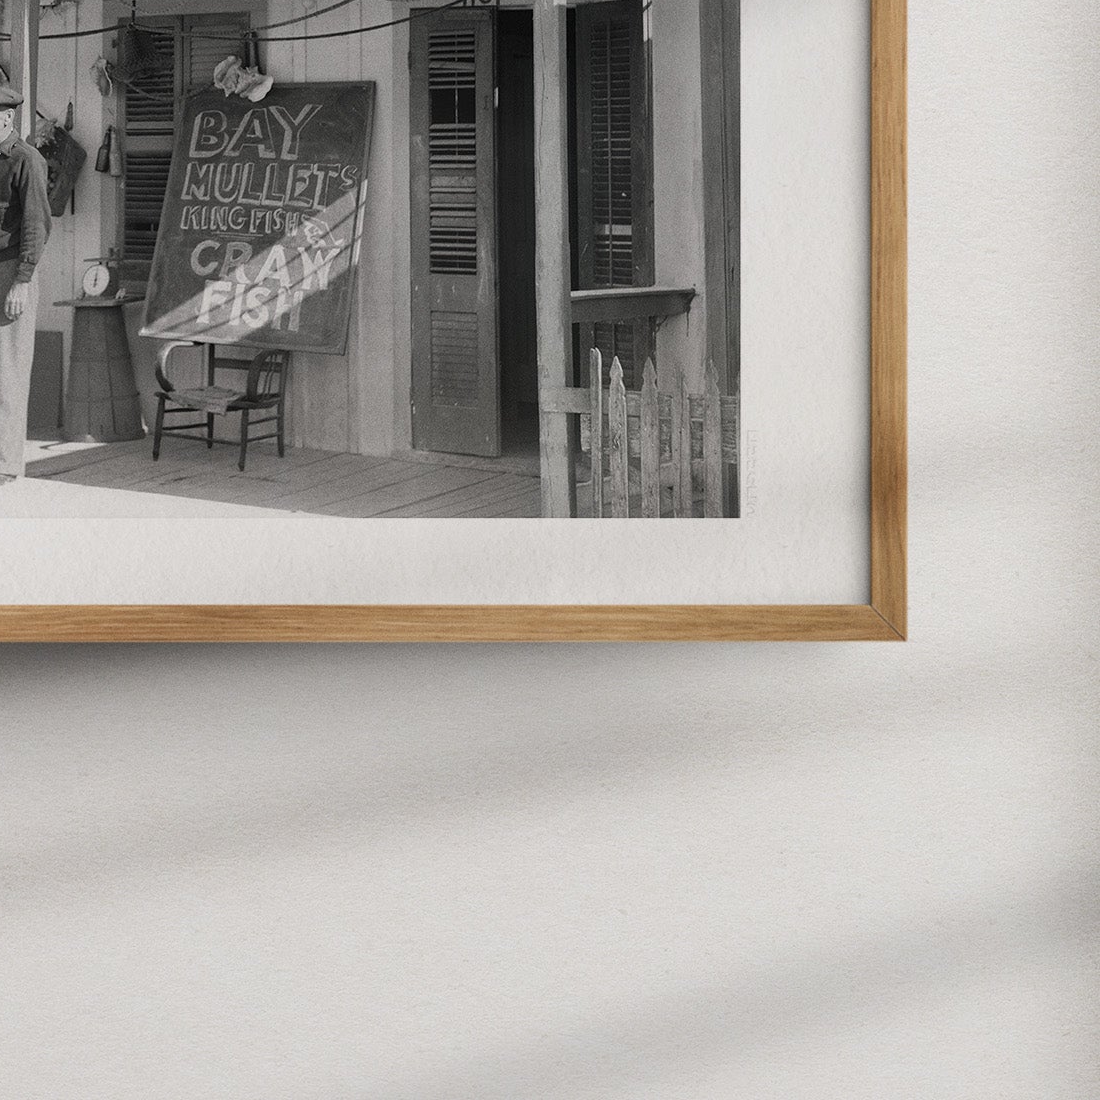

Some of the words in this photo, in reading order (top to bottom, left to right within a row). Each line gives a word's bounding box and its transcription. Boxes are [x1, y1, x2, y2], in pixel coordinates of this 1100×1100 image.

[188, 103, 323, 161] BAY
[190, 239, 342, 291] CRAW
[195, 279, 305, 333] FISH
